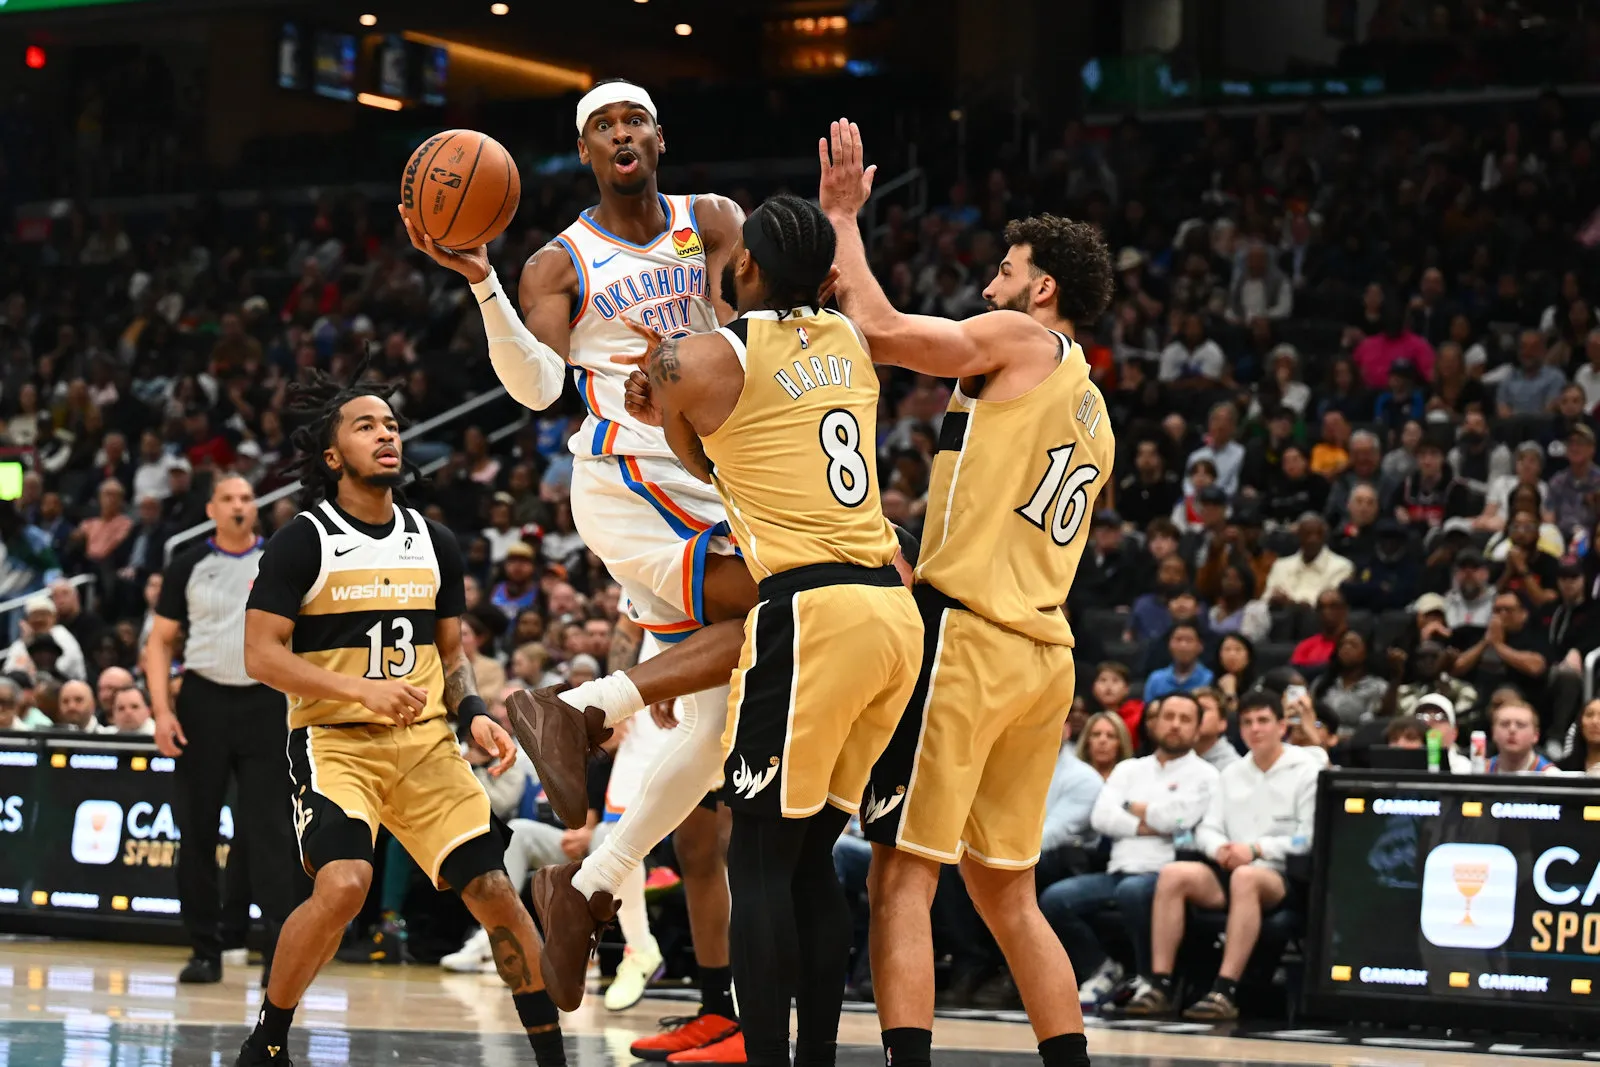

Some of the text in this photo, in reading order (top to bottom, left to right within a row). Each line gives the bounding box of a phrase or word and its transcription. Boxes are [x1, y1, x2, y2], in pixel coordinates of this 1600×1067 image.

[641, 296, 691, 334] CITY
[773, 355, 852, 400] HARDY
[818, 407, 869, 508] 8
[1013, 442, 1100, 546] 16
[331, 576, 434, 604] washington
[362, 616, 416, 679] 13
